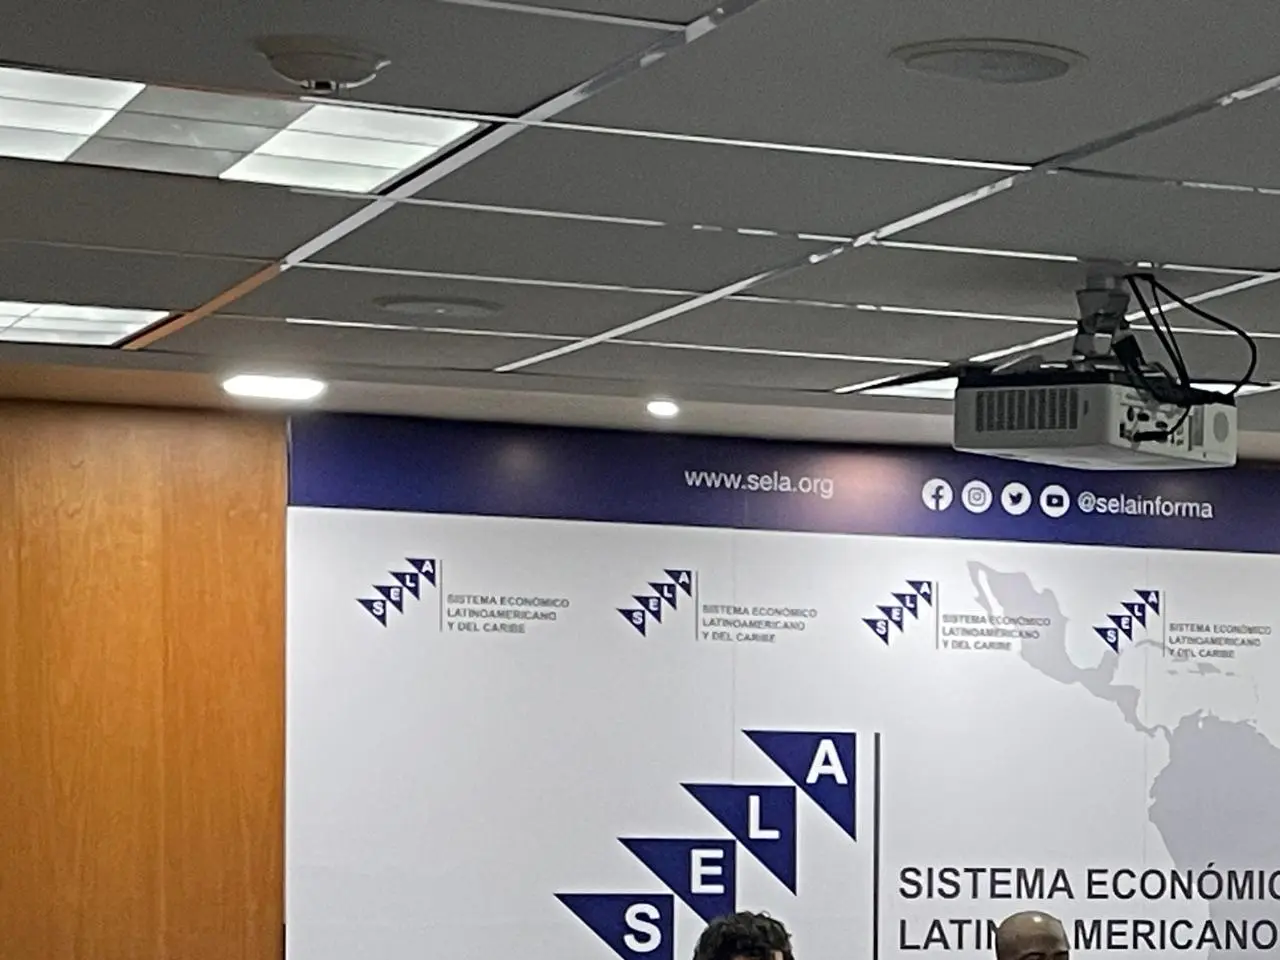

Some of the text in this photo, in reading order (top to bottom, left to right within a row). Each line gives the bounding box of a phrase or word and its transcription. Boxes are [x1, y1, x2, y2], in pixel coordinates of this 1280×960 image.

[684, 470, 834, 499] www.sela.org
[1077, 491, 1213, 518] @selainforma
[623, 738, 848, 953] SELA
[899, 867, 1075, 900] SISTEMA
